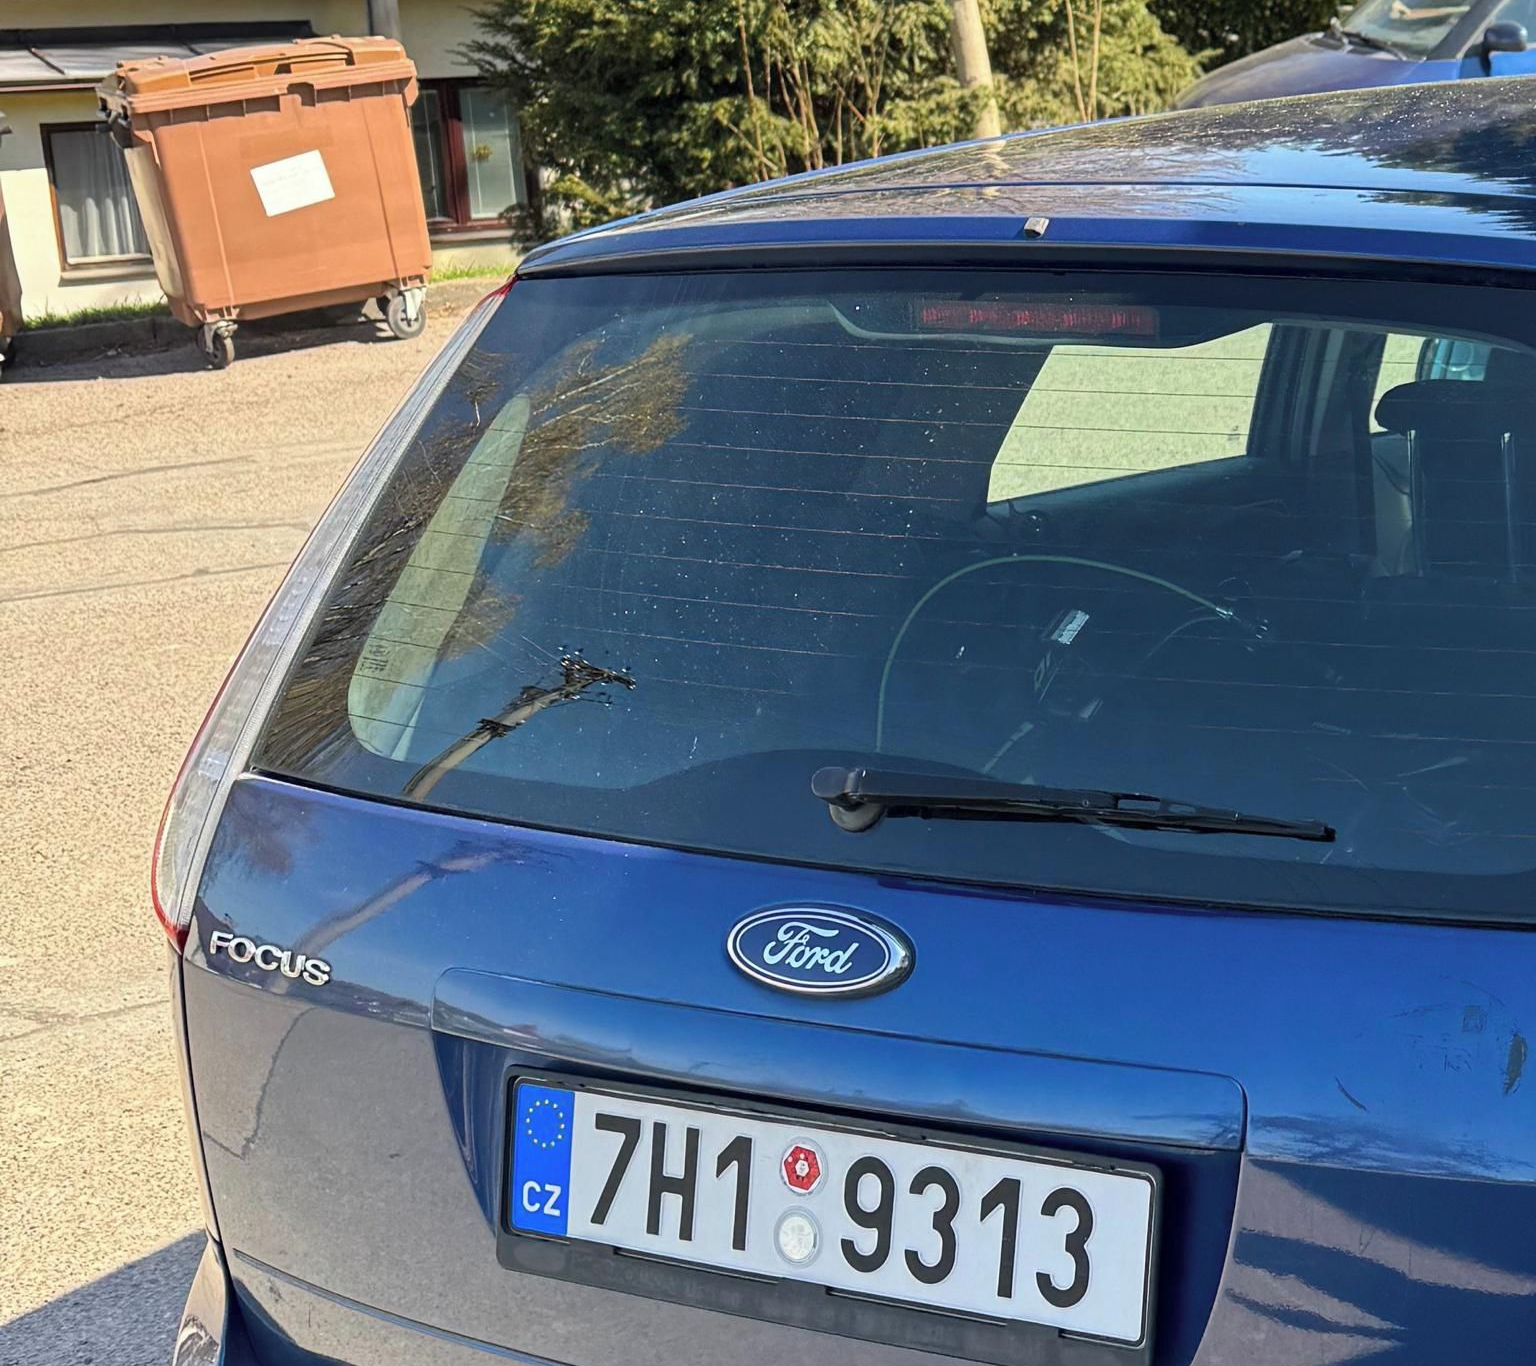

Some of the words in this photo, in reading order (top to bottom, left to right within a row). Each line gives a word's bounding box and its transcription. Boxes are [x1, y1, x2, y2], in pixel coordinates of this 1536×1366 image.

[209, 930, 331, 986] FOCUS
[763, 921, 859, 974] Ford
[522, 1180, 562, 1218] CZ
[590, 1112, 753, 1252] 7H1
[840, 1155, 1094, 1310] 9313
